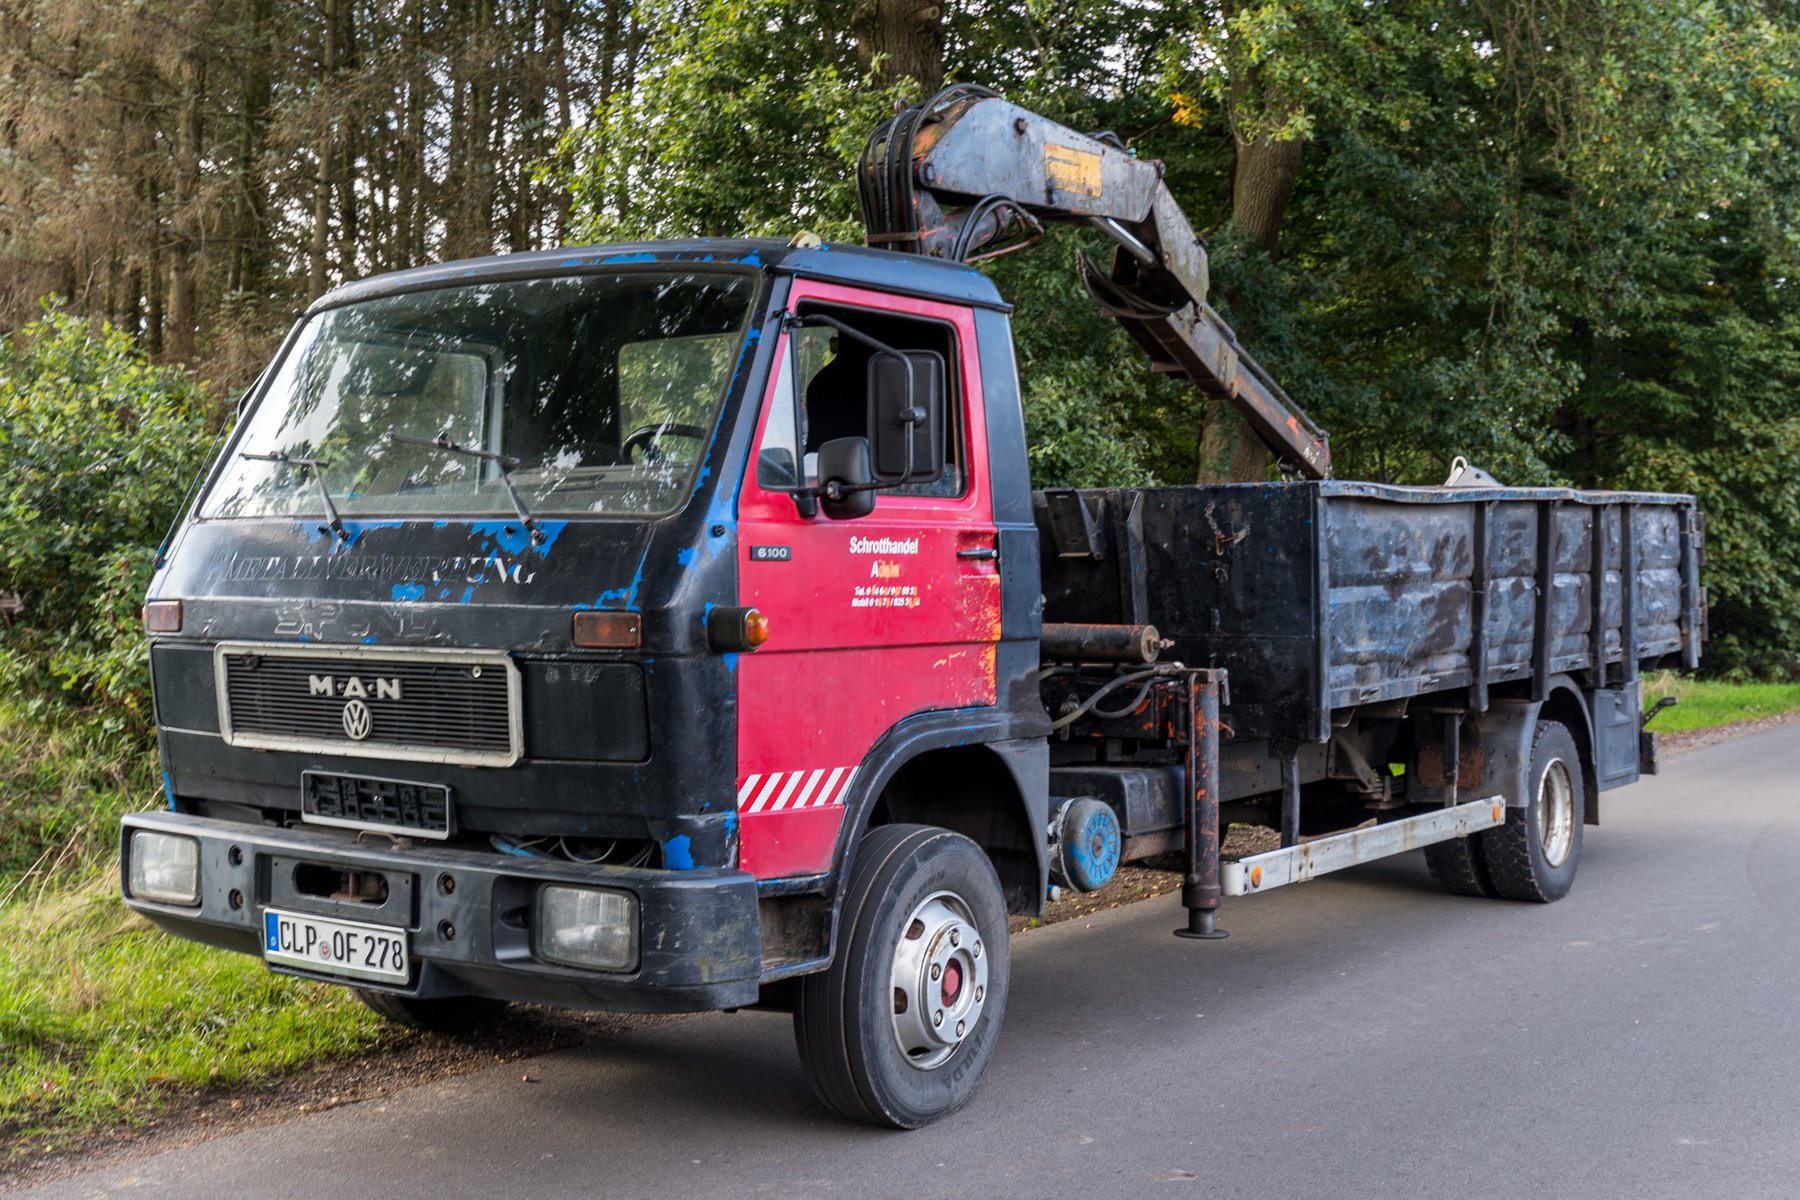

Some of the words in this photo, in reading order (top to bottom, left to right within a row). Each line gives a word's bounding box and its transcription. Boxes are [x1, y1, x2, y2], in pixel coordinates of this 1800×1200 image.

[757, 547, 788, 558] 6100
[849, 536, 919, 554] Schrotthandel
[280, 920, 317, 955] CLP
[333, 930, 358, 963] OF
[364, 935, 403, 971] 278
